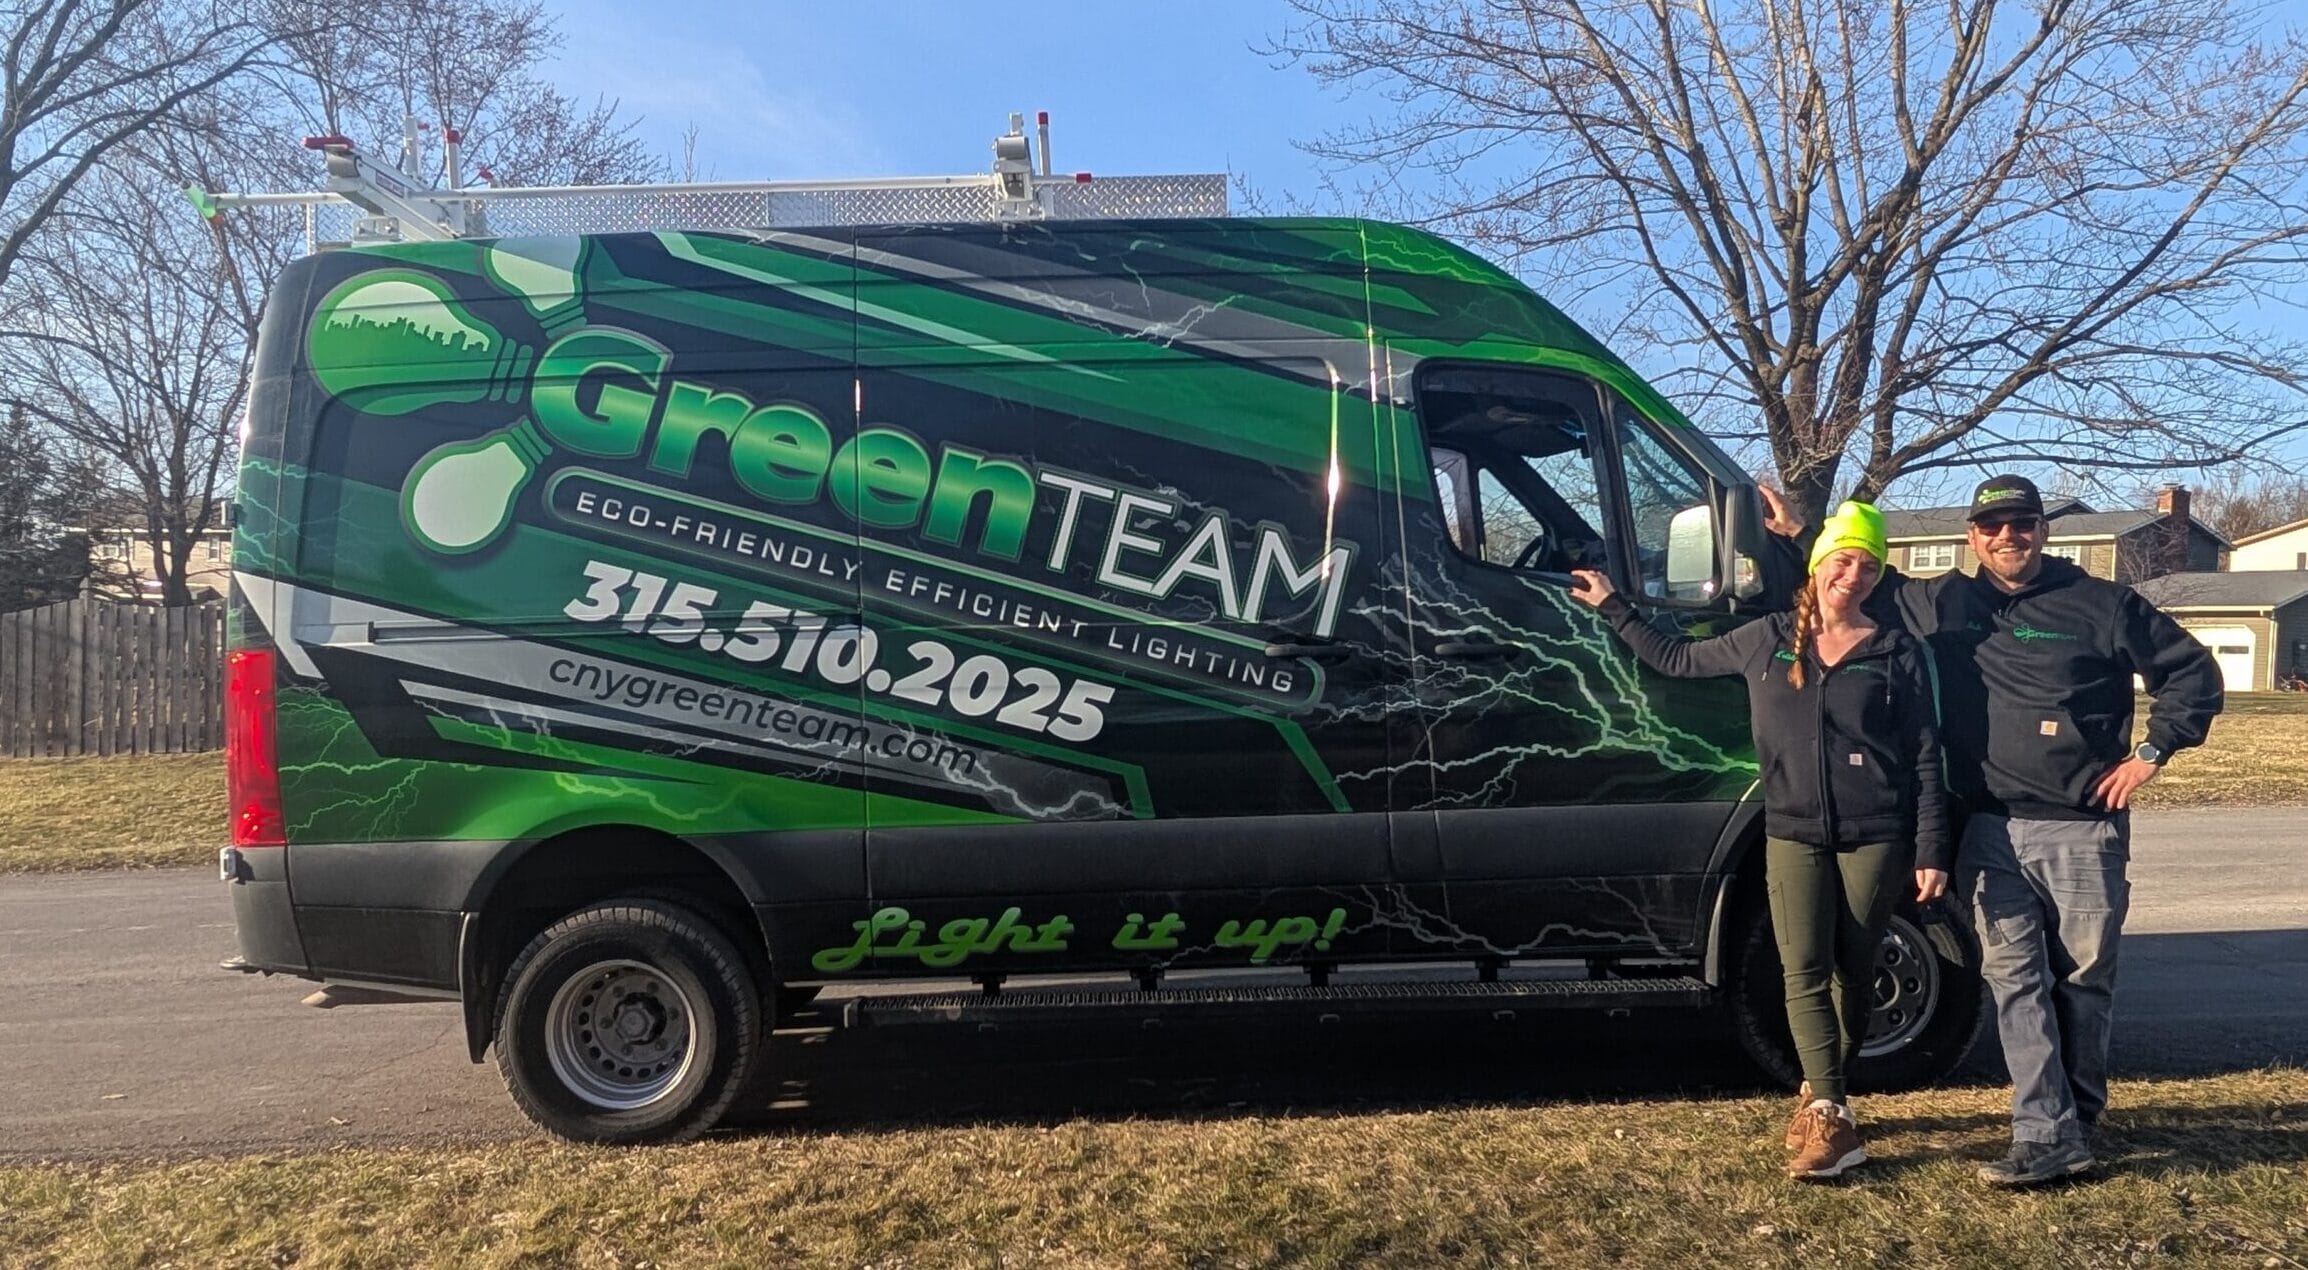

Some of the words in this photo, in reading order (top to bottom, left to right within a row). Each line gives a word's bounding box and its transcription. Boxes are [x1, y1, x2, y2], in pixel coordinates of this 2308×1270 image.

[563, 560, 1115, 741] 315.510.2025
[576, 492, 862, 580] ECO-FRIENDLY
[886, 571, 1087, 636] EFFICIENT
[1108, 627, 1293, 692] LIGHTING
[549, 659, 977, 773] cnygreenteam.com
[812, 907, 1074, 972] Light
[1112, 913, 1186, 950] it
[1214, 908, 1348, 964] up!
